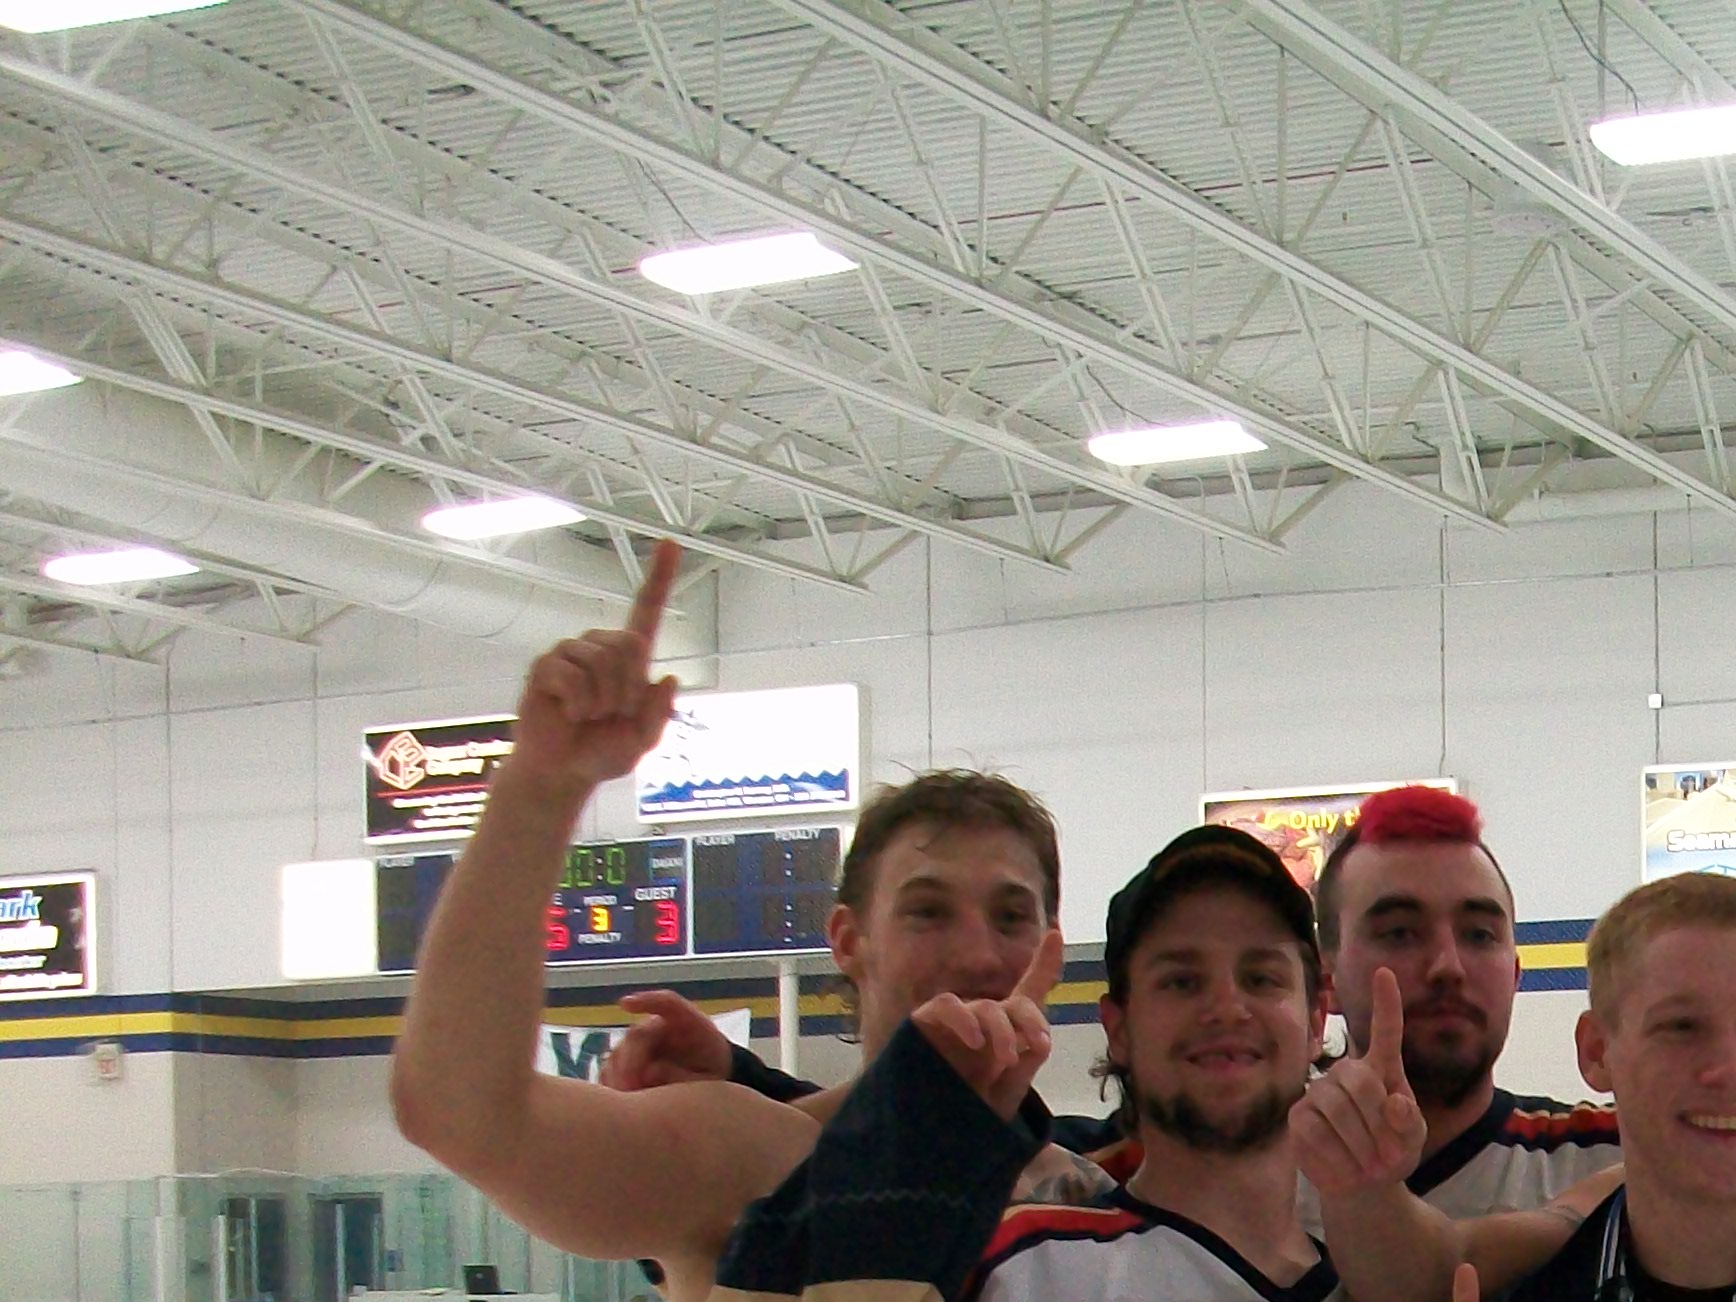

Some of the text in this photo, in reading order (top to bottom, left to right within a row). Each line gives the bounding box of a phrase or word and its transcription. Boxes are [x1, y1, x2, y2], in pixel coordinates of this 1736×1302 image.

[1289, 807, 1339, 834] Only
[696, 828, 821, 846] PLAYER PENALTY
[634, 886, 678, 901] GUEST
[590, 904, 610, 933] 3
[655, 900, 680, 945] 3
